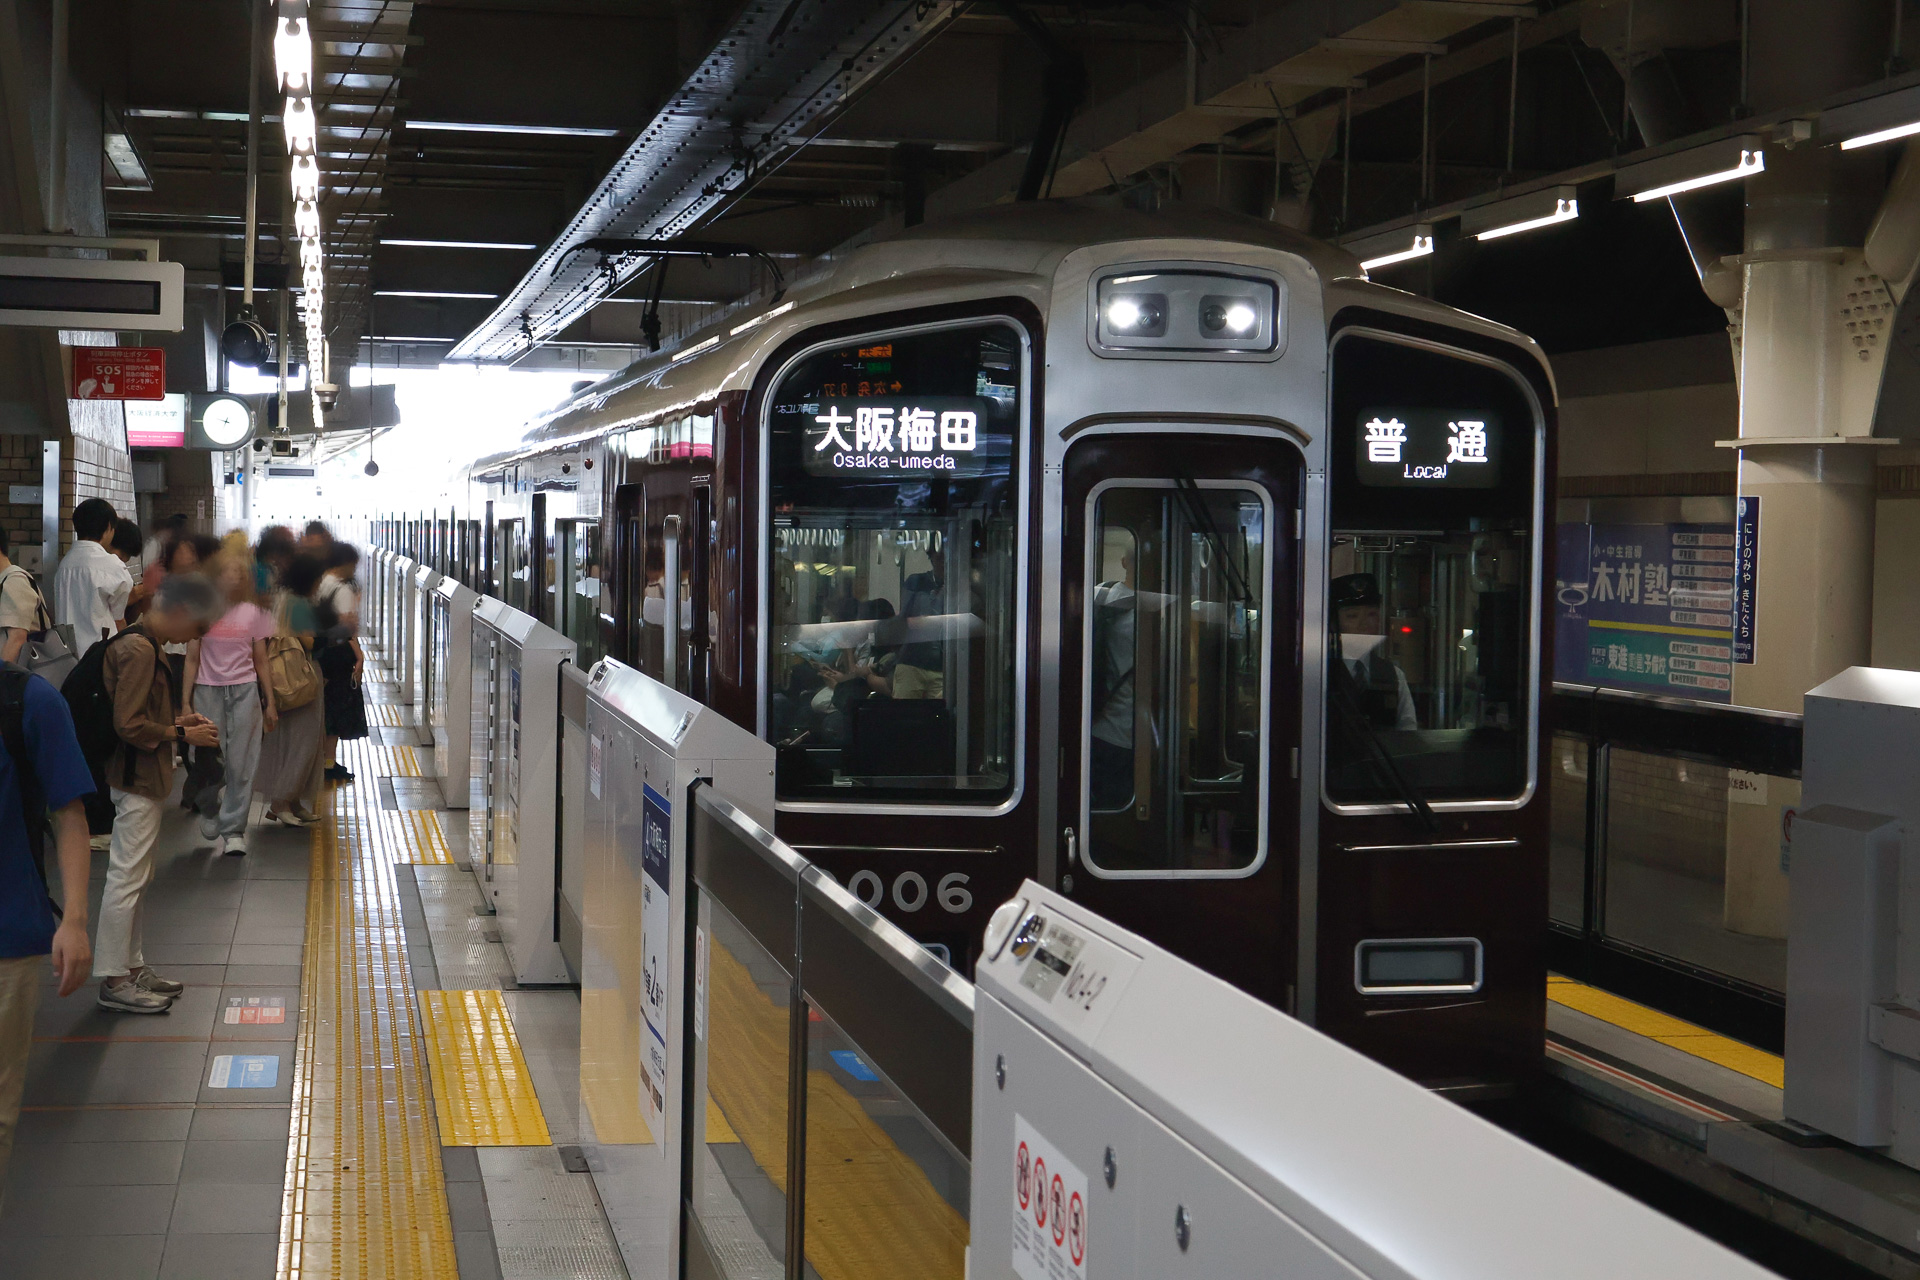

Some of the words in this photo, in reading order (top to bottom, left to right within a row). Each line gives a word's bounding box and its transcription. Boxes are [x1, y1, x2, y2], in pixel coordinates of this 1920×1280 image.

[96, 366, 121, 375] SOS
[815, 405, 977, 452] 大阪梅田
[833, 452, 956, 470] Osaka-umeda
[1403, 463, 1447, 479] Local
[1591, 561, 1669, 606] 木村塾
[1741, 589, 1751, 638] きたぐち
[818, 868, 973, 914] 006
